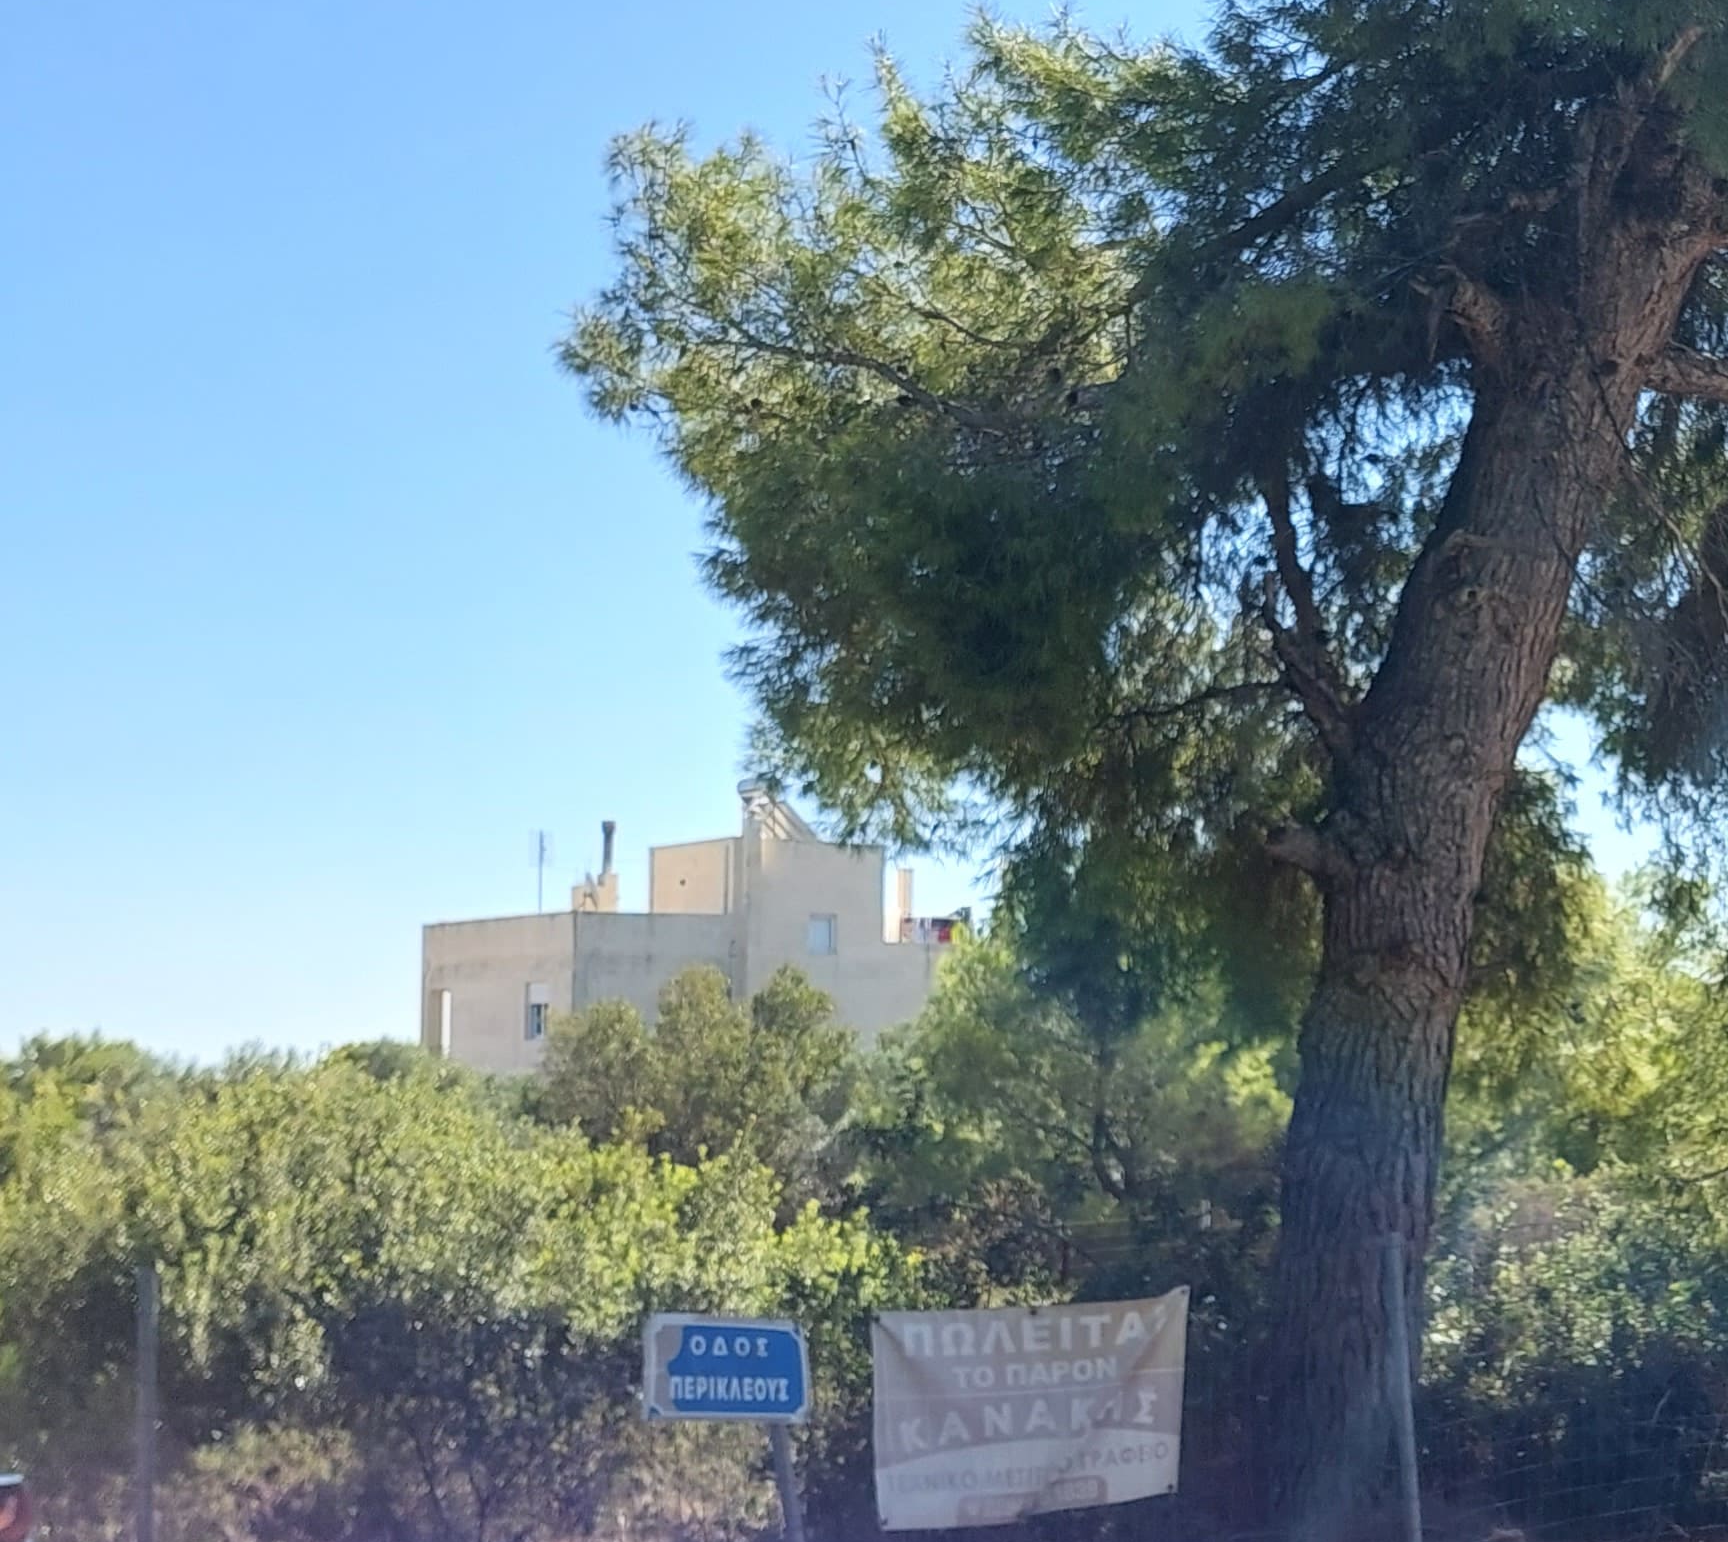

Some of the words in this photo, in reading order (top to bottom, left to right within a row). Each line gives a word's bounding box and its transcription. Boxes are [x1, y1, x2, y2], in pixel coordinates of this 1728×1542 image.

[690, 1335, 769, 1357] ΟΔΟΣ
[952, 1365, 995, 1389] ΤΟ
[1005, 1357, 1118, 1387] ΠΑΡΟΝ
[669, 1375, 790, 1402] ΠΕΡΙΚΛΕΟΥΣ
